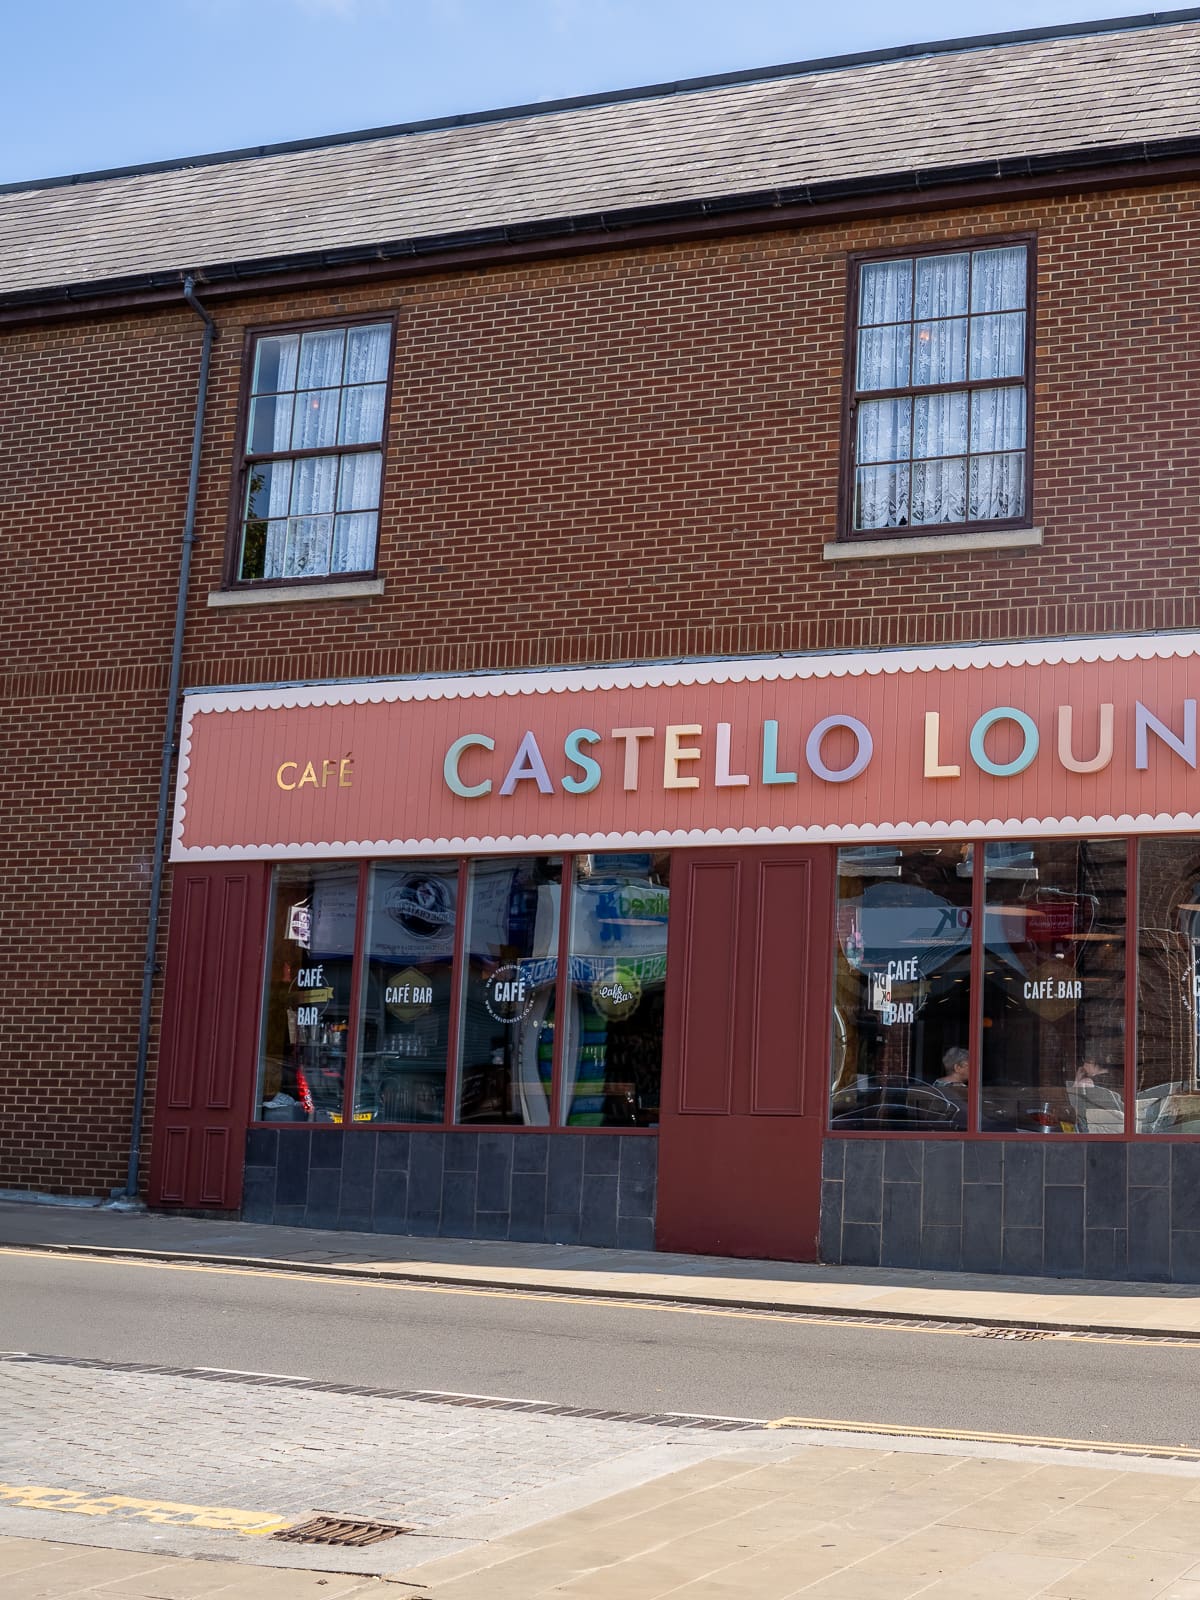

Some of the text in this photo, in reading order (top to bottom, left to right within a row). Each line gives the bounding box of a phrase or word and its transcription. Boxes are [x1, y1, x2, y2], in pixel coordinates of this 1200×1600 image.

[444, 714, 874, 798] CASTELLO
[277, 752, 354, 790] CAFÉ
[297, 964, 324, 987] CAFÉ
[888, 956, 918, 980] CAFÉ
[385, 983, 432, 1003] CAFÉ BAR
[494, 977, 525, 1002] CAFÉ
[600, 984, 623, 999] Café
[613, 992, 633, 1005] Bar
[1024, 977, 1082, 999] CAFÉ BAR
[297, 1007, 318, 1026] BAR
[890, 1003, 914, 1024] BAR
